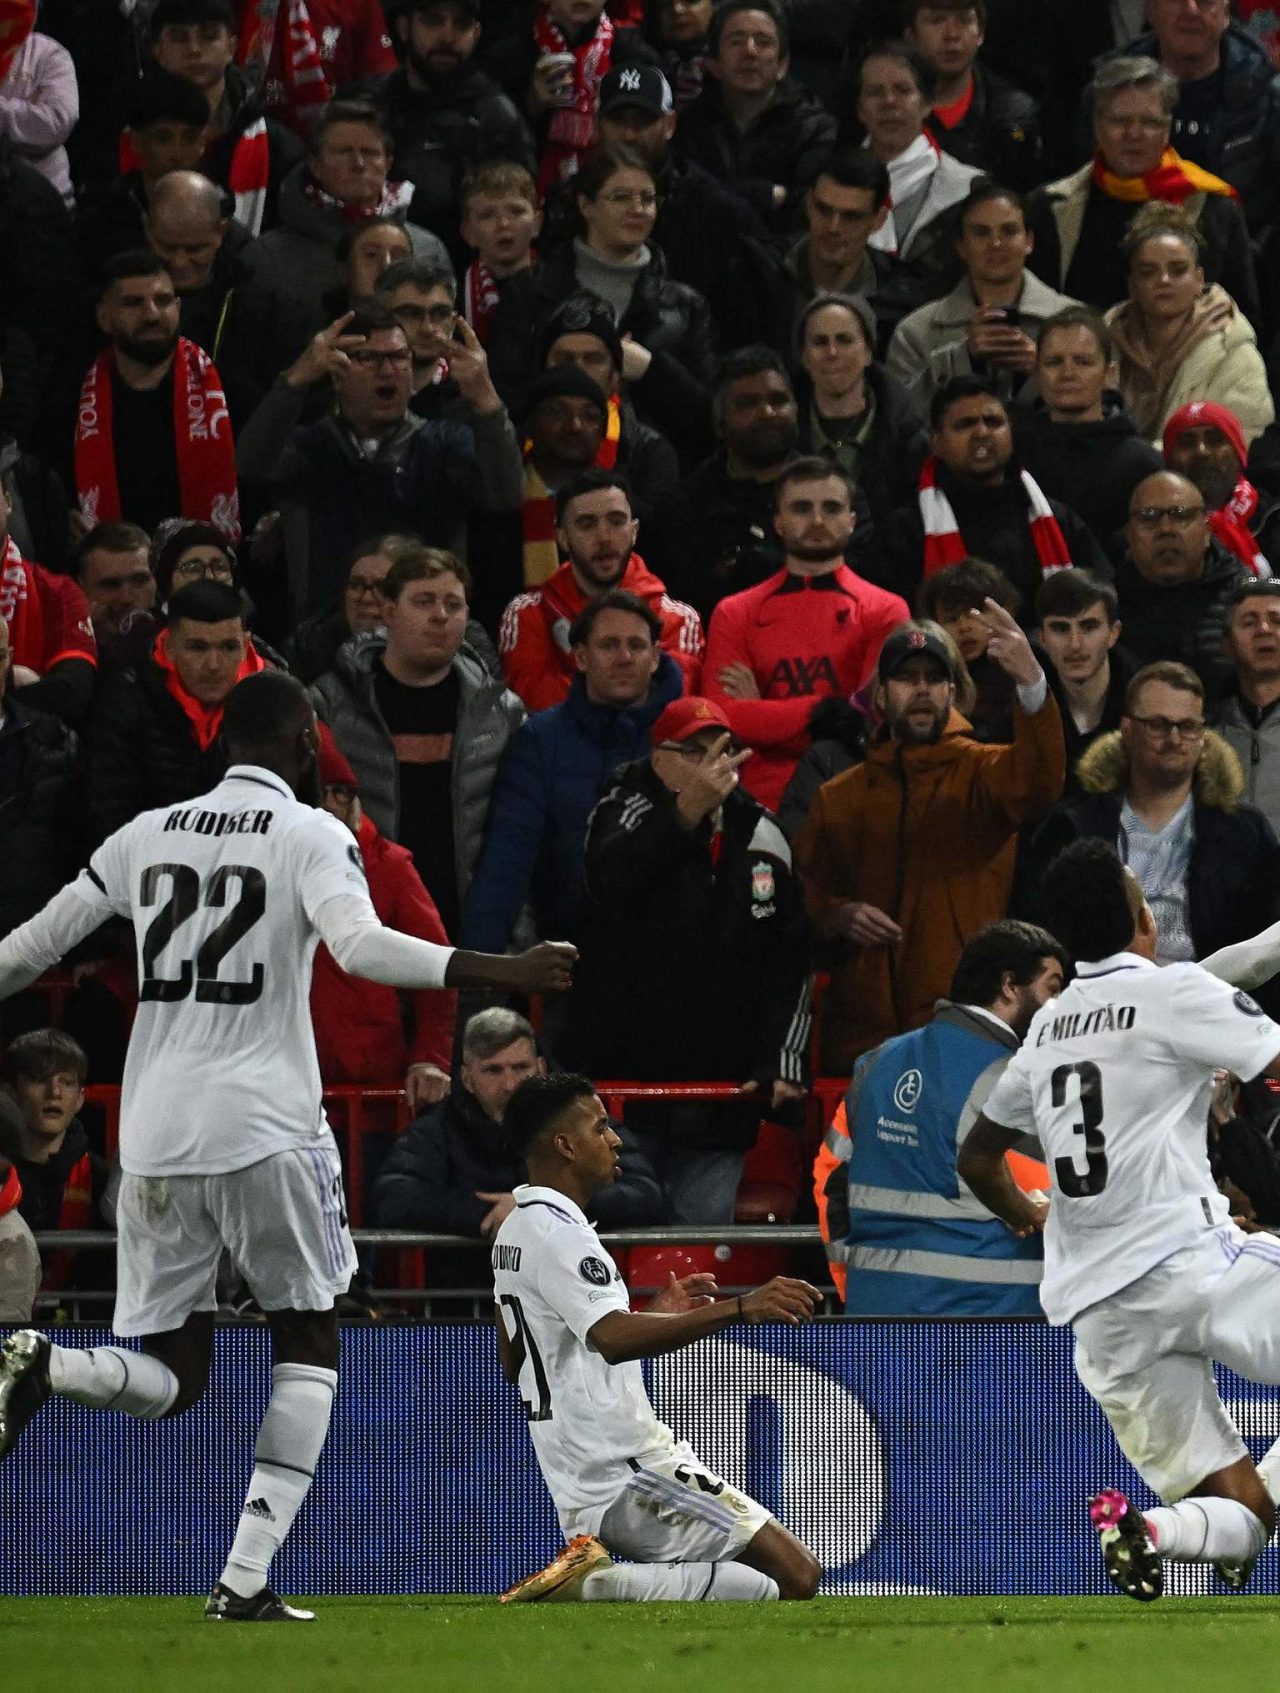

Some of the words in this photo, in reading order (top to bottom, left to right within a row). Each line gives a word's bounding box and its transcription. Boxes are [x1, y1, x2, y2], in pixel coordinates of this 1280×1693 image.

[761, 655, 841, 700] AXA
[139, 862, 267, 1005] 22
[1051, 1060, 1109, 1199] 3
